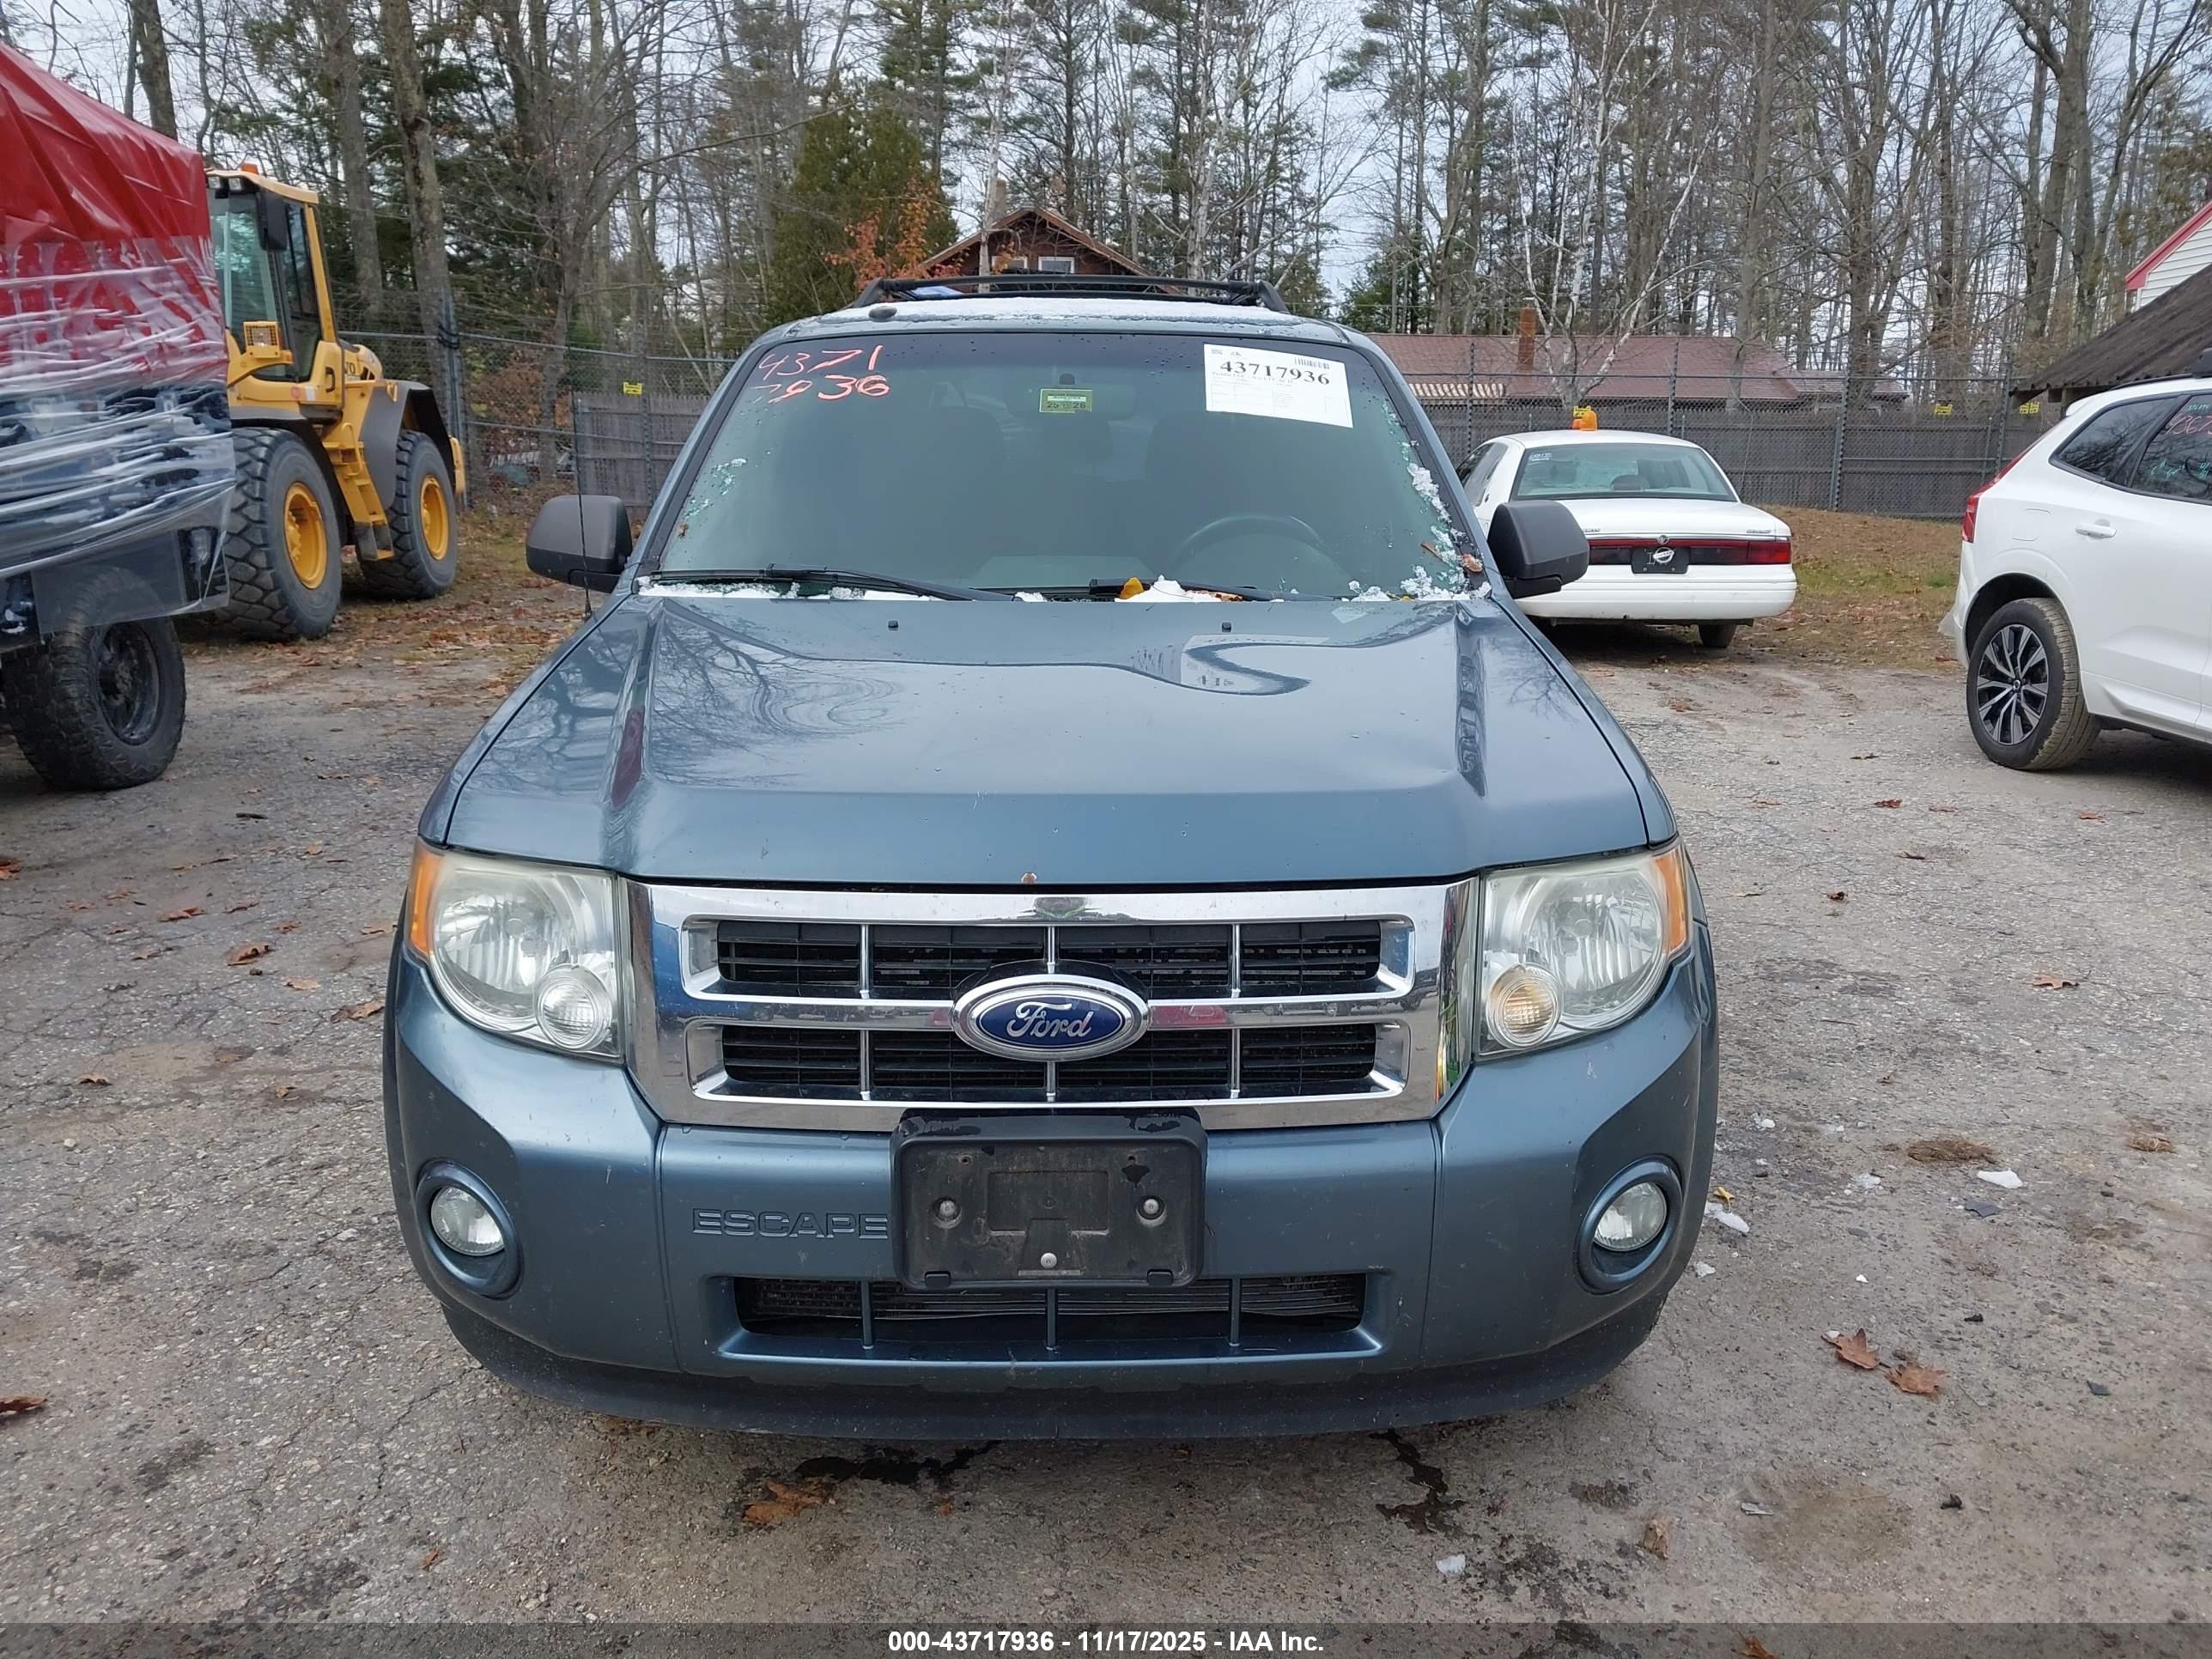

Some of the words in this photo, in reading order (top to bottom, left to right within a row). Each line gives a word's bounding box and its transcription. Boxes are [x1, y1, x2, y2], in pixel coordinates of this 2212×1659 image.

[758, 344, 884, 380] 4371
[1219, 360, 1330, 385] 43717936
[1006, 1001, 1094, 1037] Ford
[692, 1208, 889, 1239] ESCAPE
